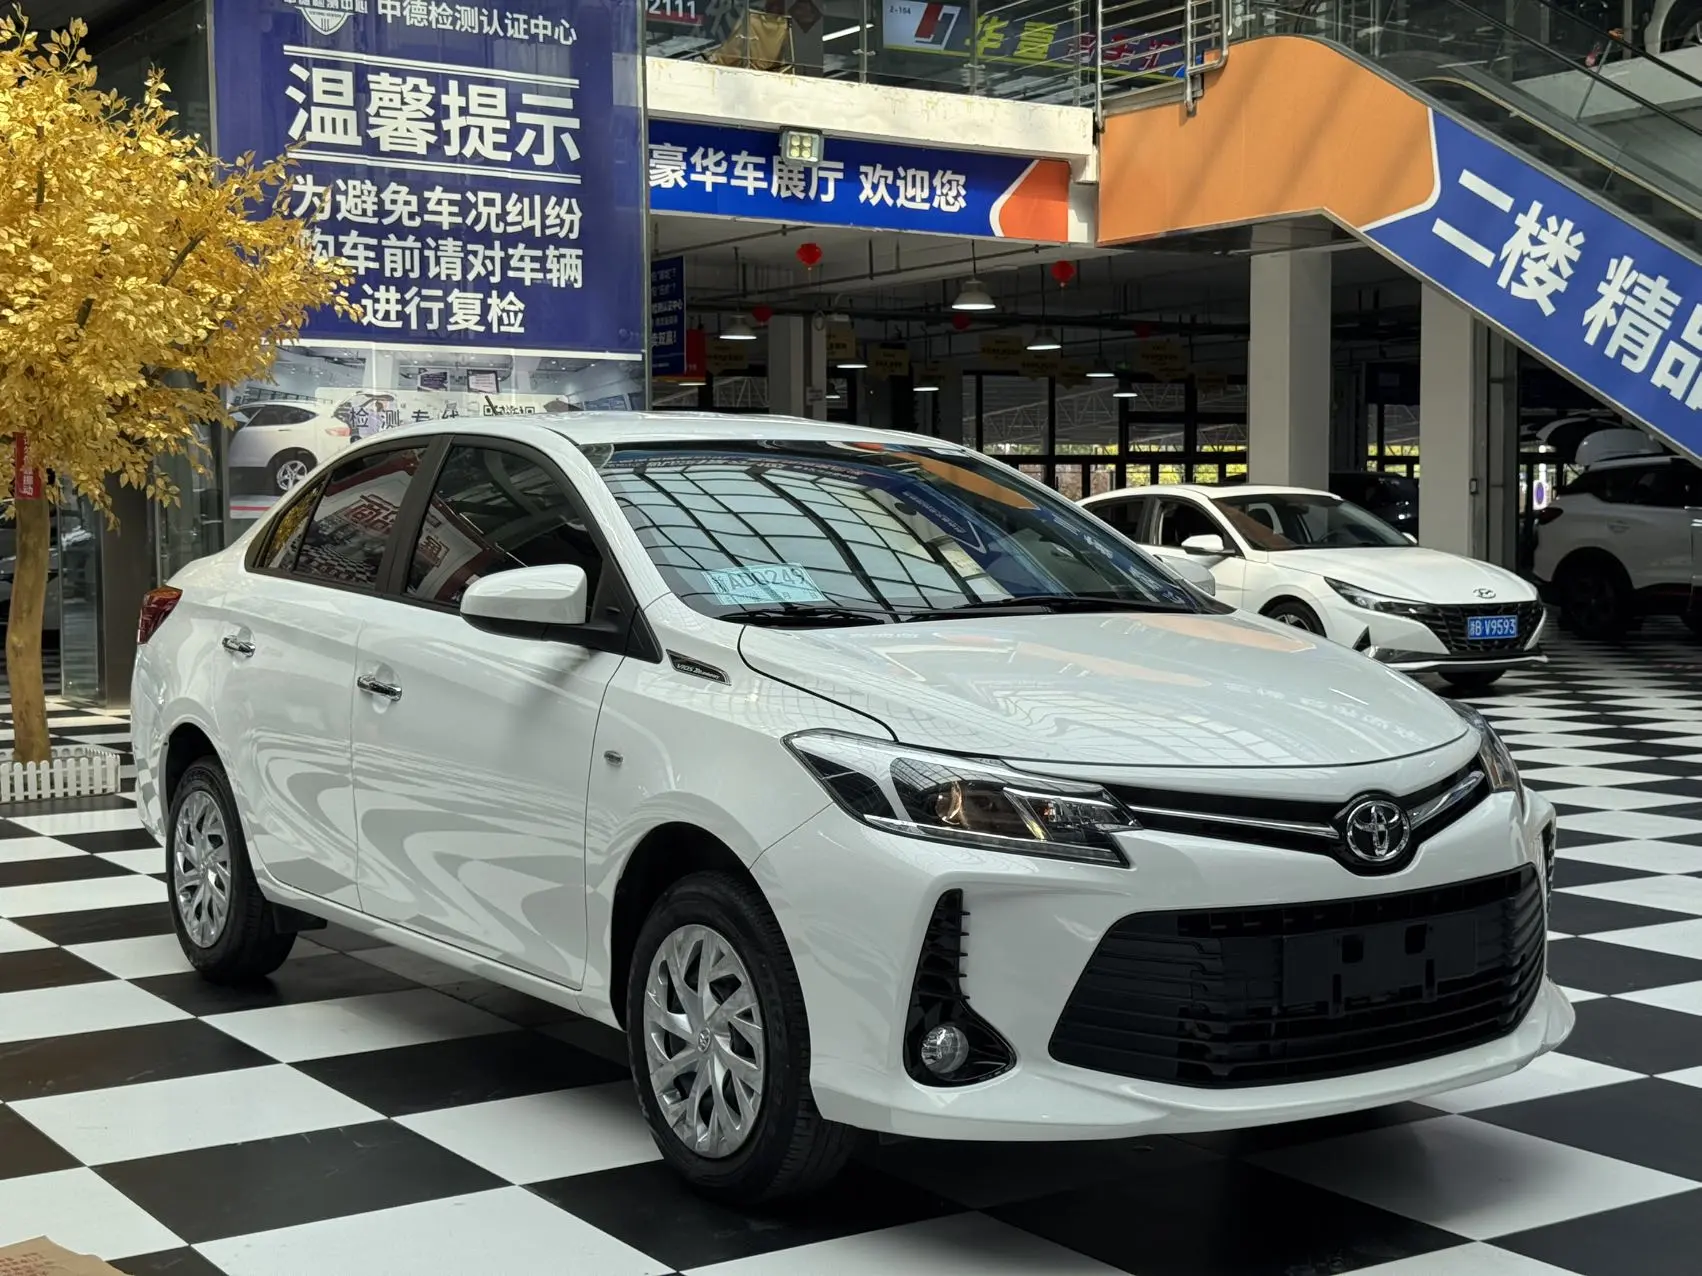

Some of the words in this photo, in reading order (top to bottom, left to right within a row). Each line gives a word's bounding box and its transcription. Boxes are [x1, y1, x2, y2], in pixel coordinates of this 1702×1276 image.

[377, 0, 578, 46] 中德检测认证中心
[645, 0, 696, 19] 2111
[284, 62, 581, 167] 温馨提示
[292, 174, 583, 241] 为避免车况纠纷
[649, 143, 844, 203] 豪华车展厅
[859, 163, 967, 213] 欢迎您
[1432, 168, 1585, 317] 二楼
[361, 284, 526, 334] 进行复检
